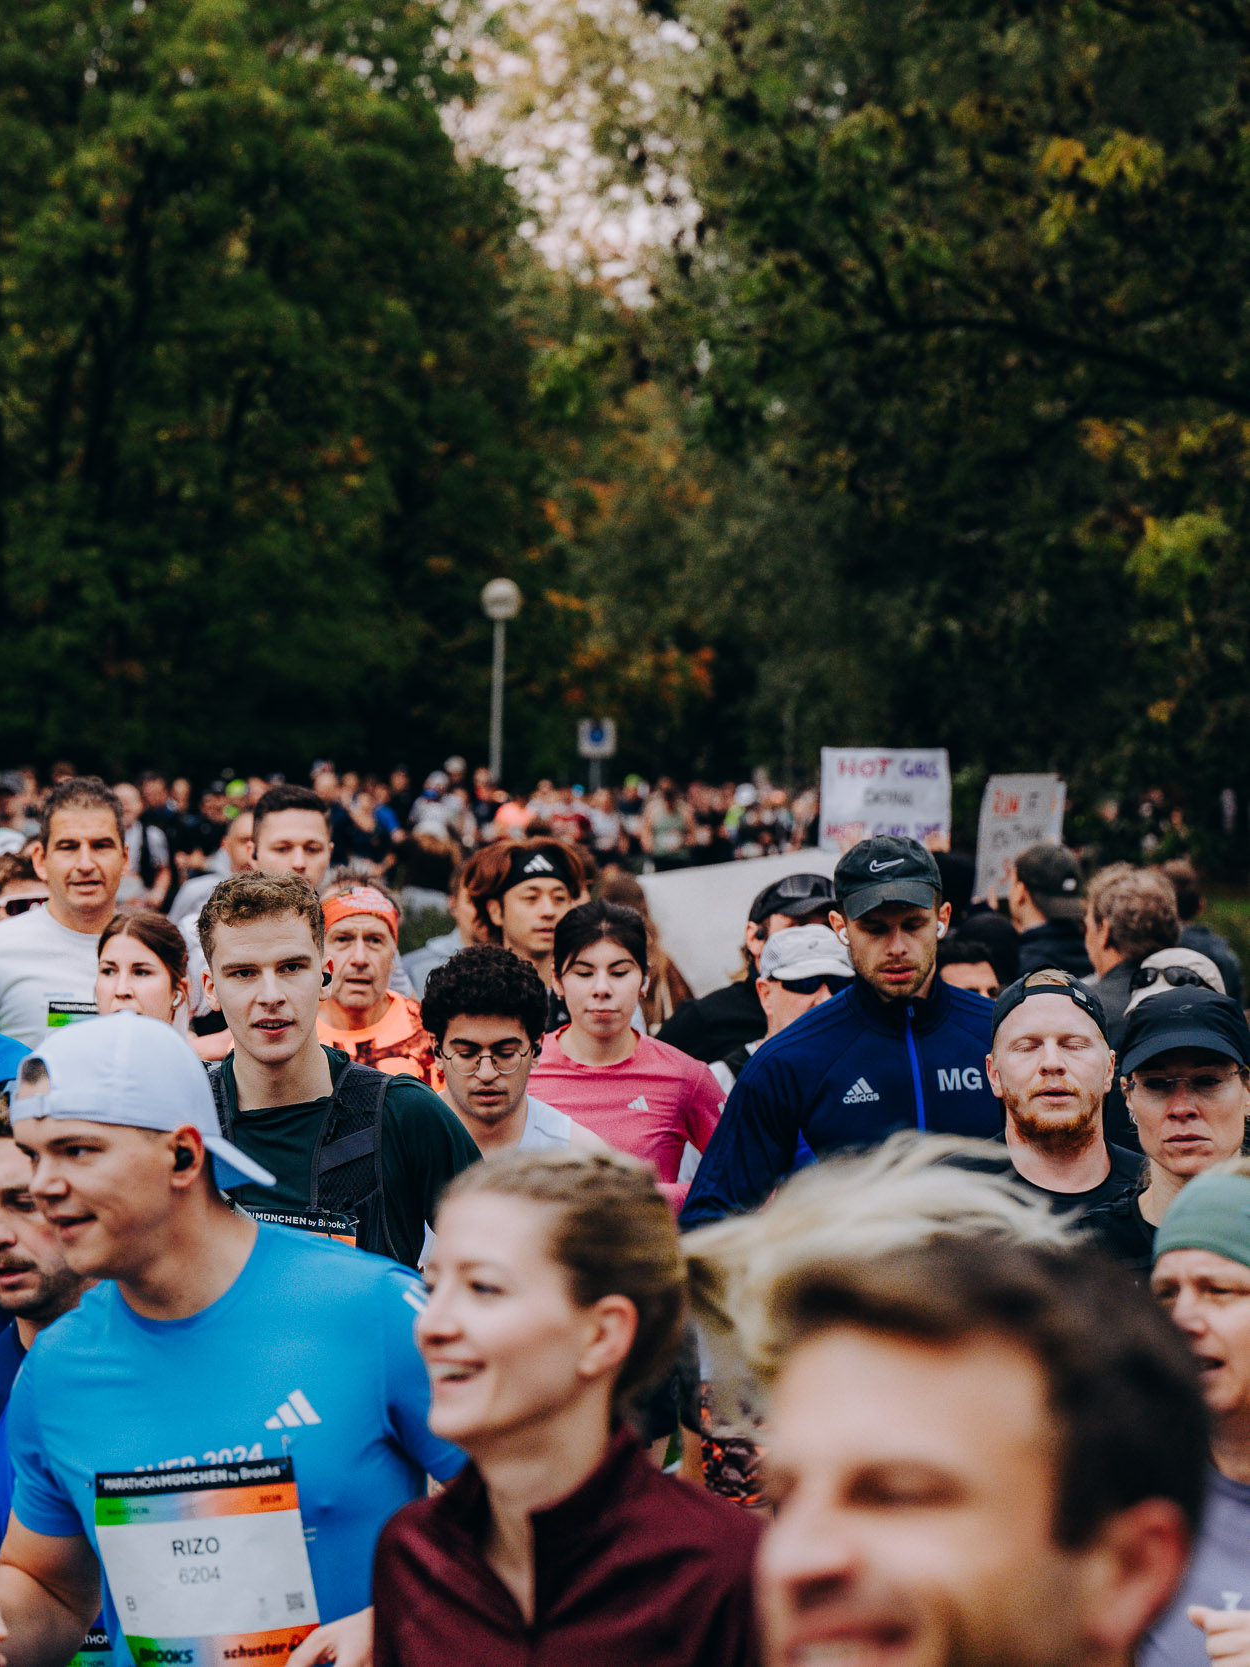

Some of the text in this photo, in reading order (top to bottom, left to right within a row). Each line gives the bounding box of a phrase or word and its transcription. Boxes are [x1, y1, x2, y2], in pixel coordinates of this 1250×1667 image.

[838, 757, 893, 777] HOT
[937, 1067, 983, 1092] MG
[842, 1092, 880, 1105] adidas
[308, 1218, 317, 1227] by
[239, 1464, 281, 1481] Brooks
[172, 1536, 220, 1556] RIZO
[178, 1566, 221, 1584] 6204
[139, 1648, 194, 1664] BROOKS
[223, 1641, 287, 1660] schuster
